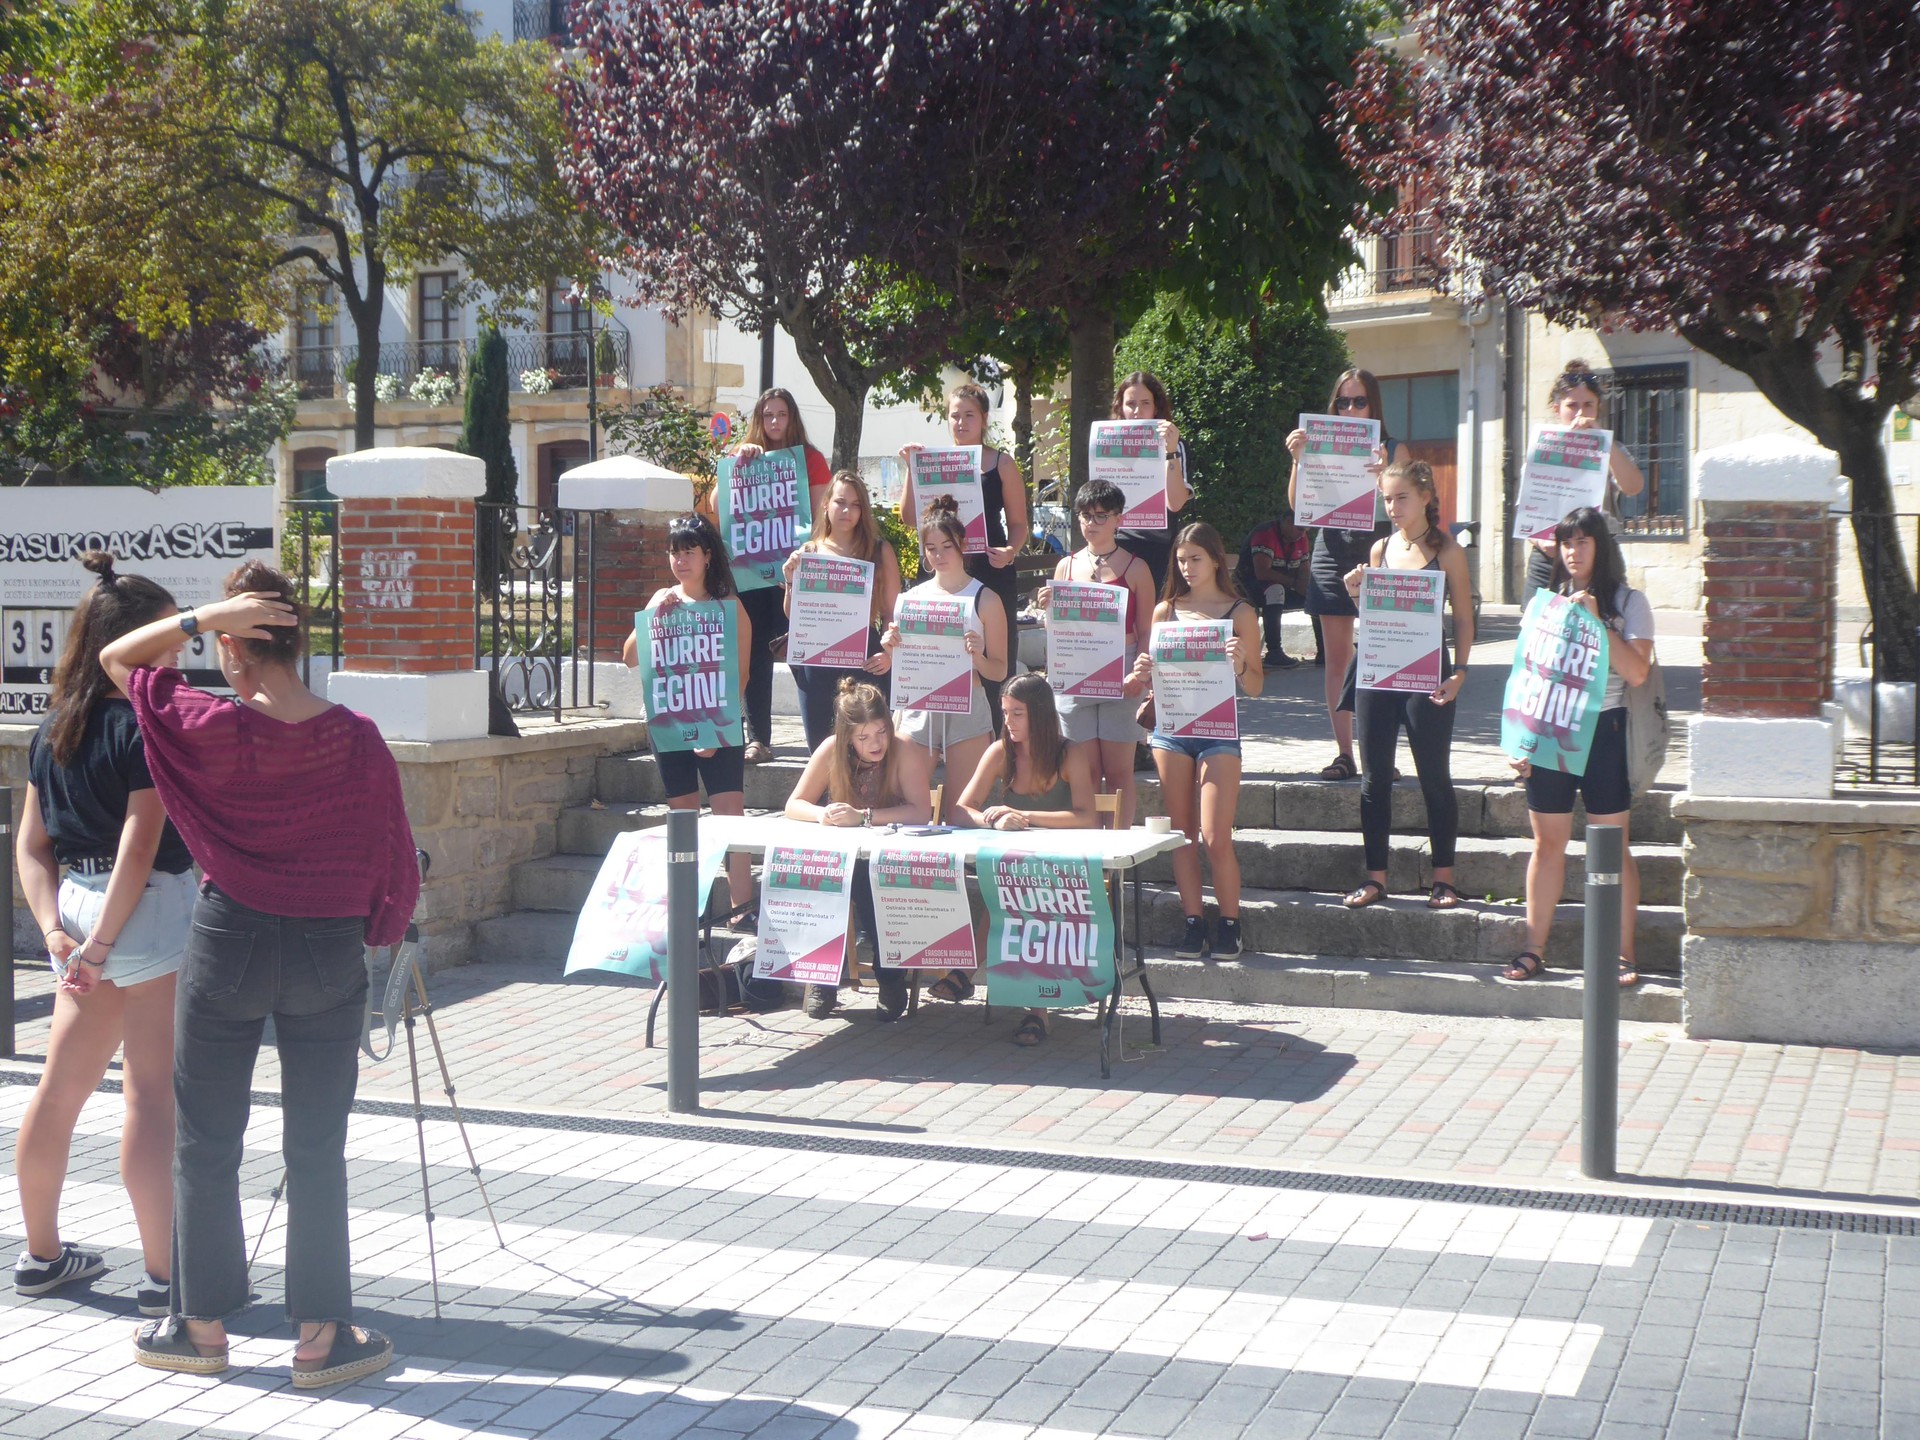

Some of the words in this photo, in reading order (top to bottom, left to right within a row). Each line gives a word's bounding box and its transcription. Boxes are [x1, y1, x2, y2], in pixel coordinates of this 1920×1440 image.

[728, 457, 796, 477] Indarkeria
[728, 472, 770, 488] matxista
[774, 469, 797, 482] orori
[730, 480, 799, 515] AURRE
[730, 515, 800, 556] EGIN!
[360, 550, 417, 577] STOP
[361, 579, 414, 608] TAV
[647, 610, 724, 627] Indarkeria
[648, 624, 692, 639] matxista
[697, 622, 724, 633] orori
[651, 633, 725, 668] AURRE
[1523, 630, 1600, 681] AURRE
[652, 671, 728, 714] EGIN!
[1509, 669, 1590, 732] EGIN!
[811, 854, 838, 863] festetan
[873, 864, 910, 875] ETXERATZE
[912, 867, 960, 878] KOLEKTIBOAK
[886, 852, 918, 862] Altsasuko
[919, 855, 947, 864] festetan
[992, 858, 1088, 875] Indarkeria
[994, 874, 1052, 887] matxista
[1058, 877, 1090, 888] orori
[768, 899, 792, 908] Etxeratze
[997, 887, 1095, 915] AURRE
[1000, 918, 1098, 967] EGIN!
[388, 988, 400, 1007] EOS
[395, 951, 411, 985] DIGITAL
